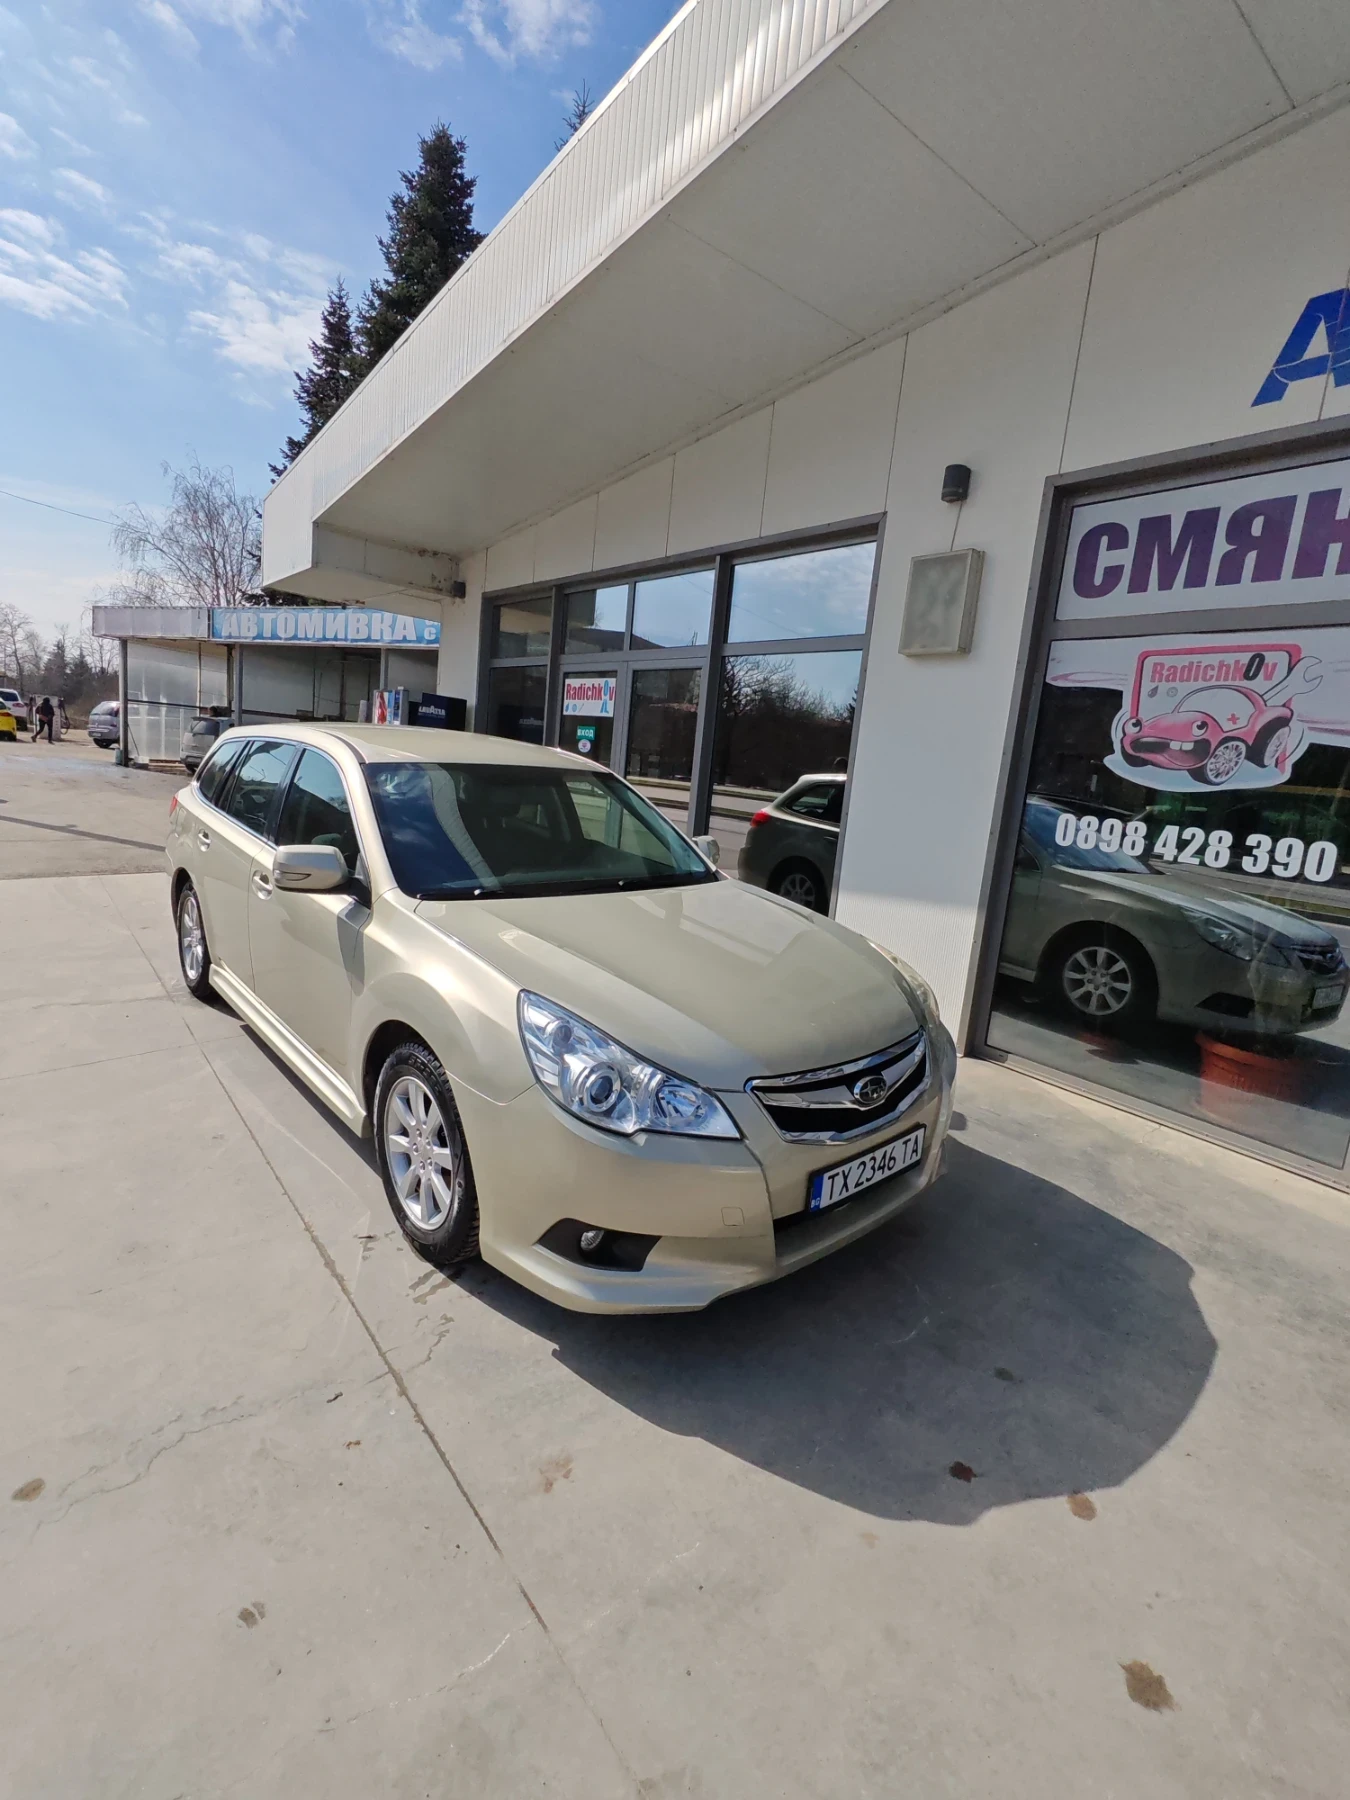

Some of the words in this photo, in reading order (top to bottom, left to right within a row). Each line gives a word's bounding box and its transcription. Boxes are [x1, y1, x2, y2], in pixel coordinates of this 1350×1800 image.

[221, 612, 417, 641] АВТОМИВКА
[1055, 813, 1148, 857] 0898
[1154, 824, 1233, 869] 428
[1241, 833, 1338, 883] 390
